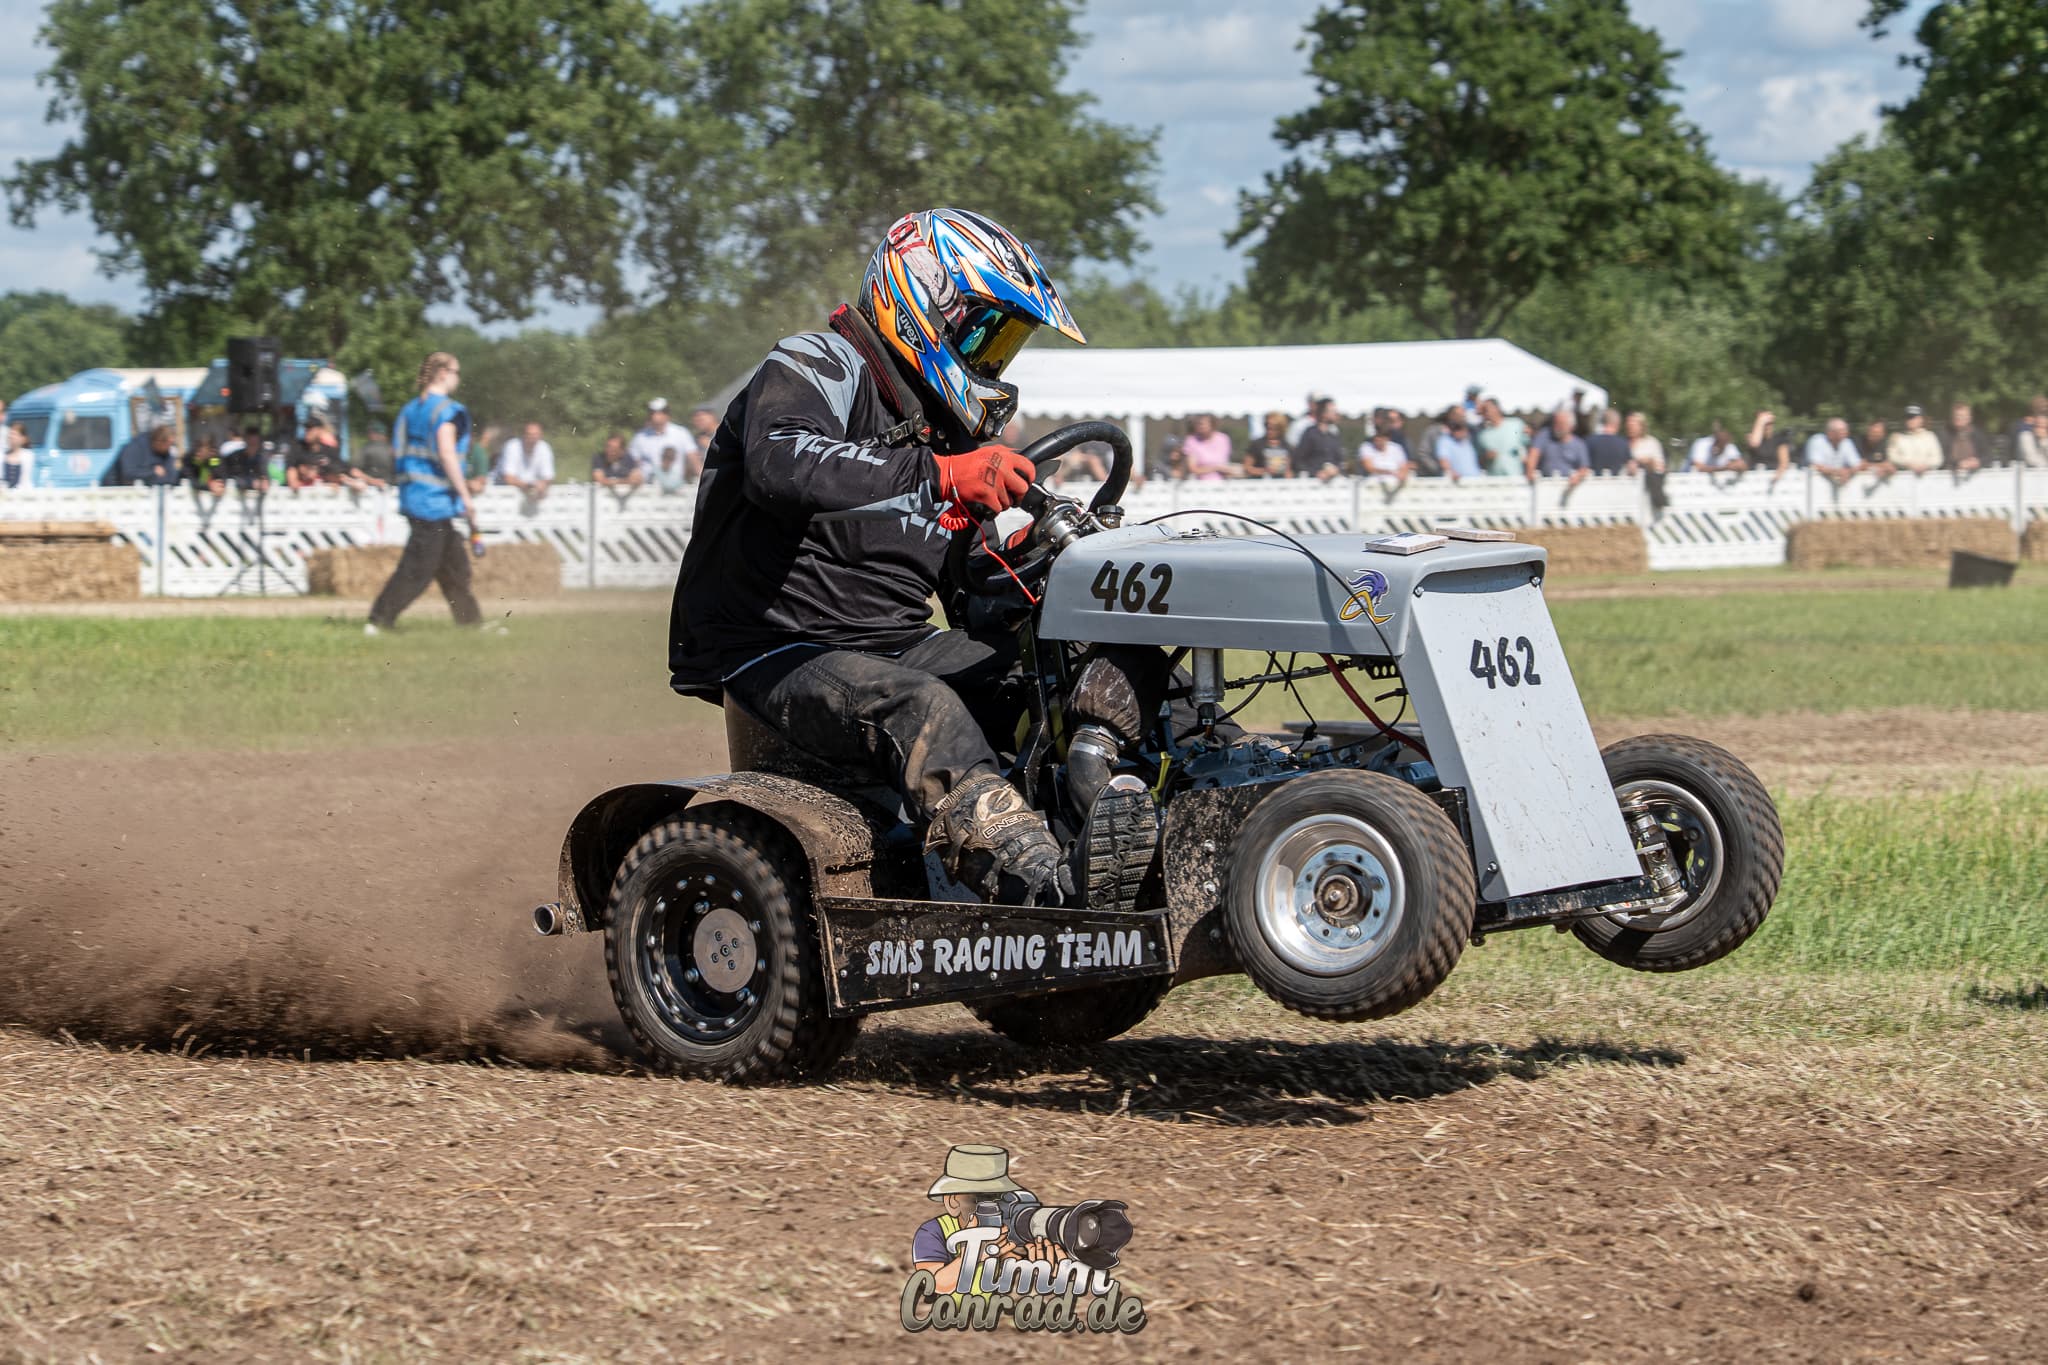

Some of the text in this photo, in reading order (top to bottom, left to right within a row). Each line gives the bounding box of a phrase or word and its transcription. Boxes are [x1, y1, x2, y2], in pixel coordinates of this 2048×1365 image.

[899, 313, 919, 344] uvex
[1091, 559, 1173, 615] 462
[1469, 635, 1542, 690] 462
[865, 930, 1142, 976] SMS RACING TEAM
